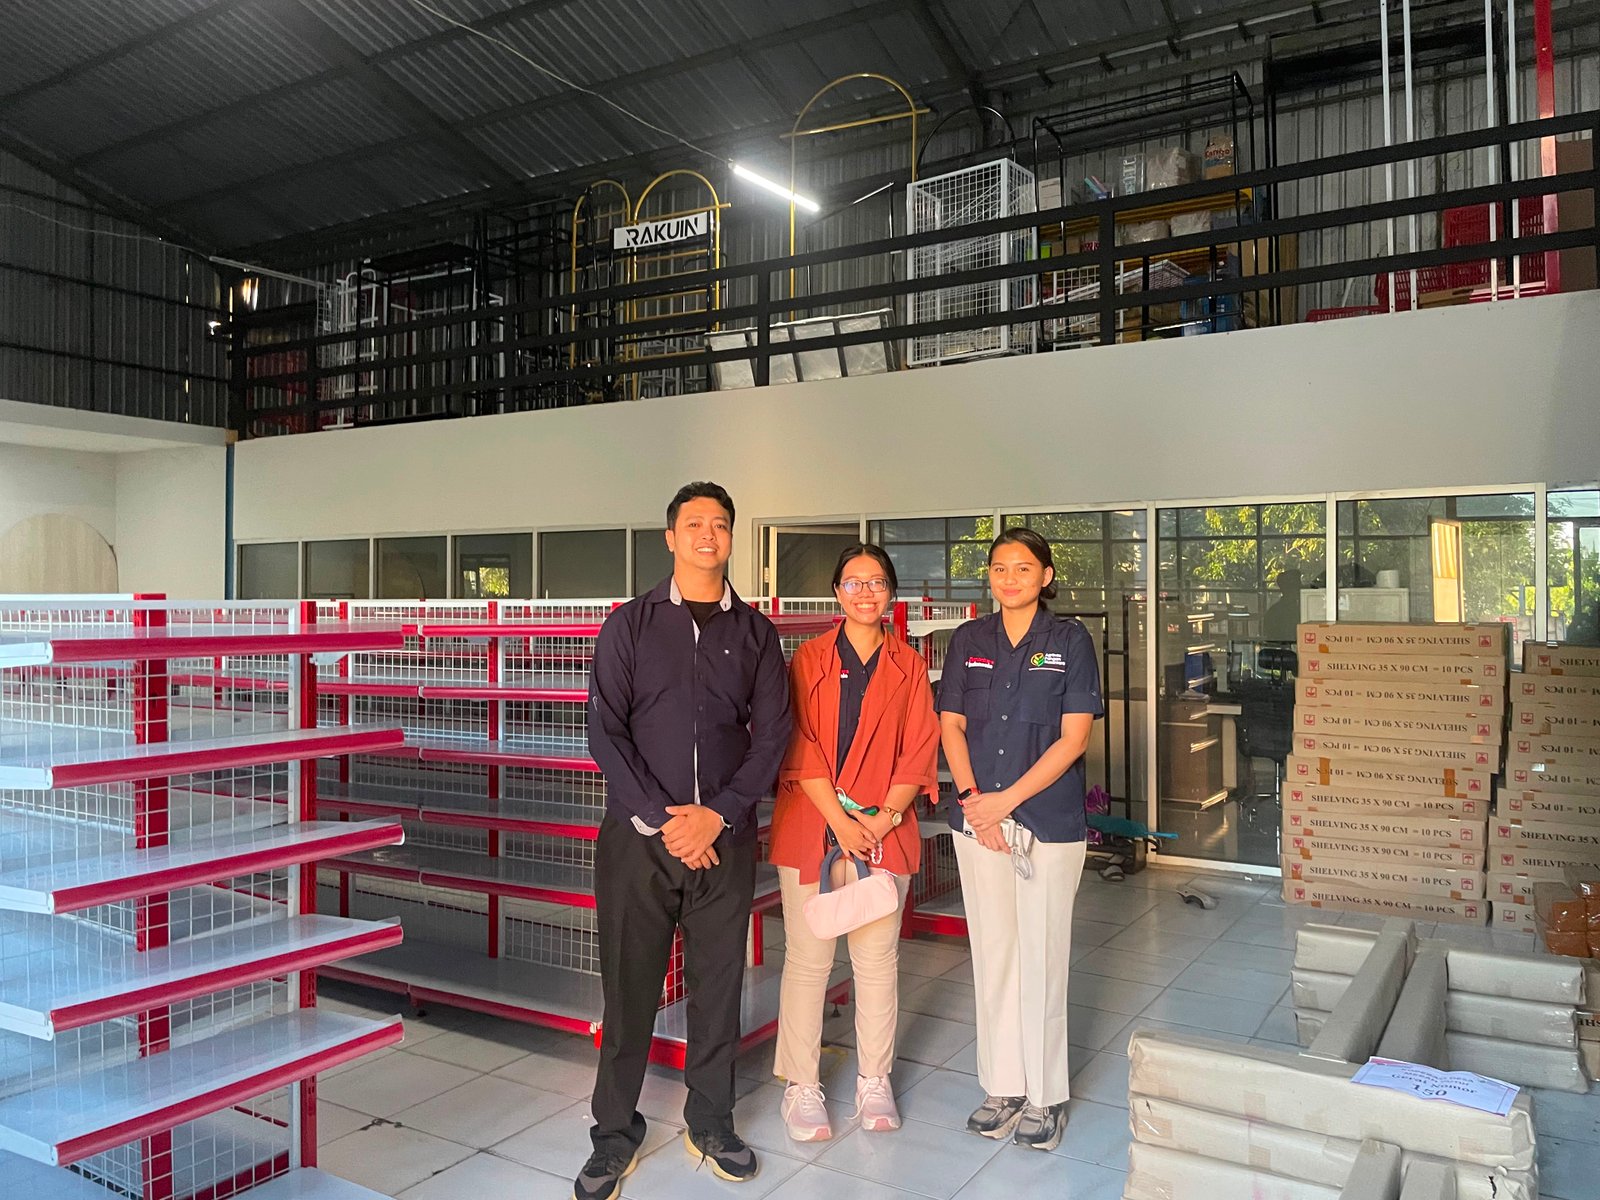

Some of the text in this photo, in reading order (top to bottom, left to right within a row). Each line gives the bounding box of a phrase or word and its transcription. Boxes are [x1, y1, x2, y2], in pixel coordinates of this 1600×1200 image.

[626, 217, 698, 246] RAKUIN
[1417, 693, 1470, 702] SHELVING
[1545, 716, 1564, 724] PCS
[1416, 722, 1467, 732] SHELVING
[1415, 748, 1466, 759] SHELVING
[1312, 795, 1359, 804] SHELVING
[1310, 820, 1357, 830] SHELVING
[1521, 831, 1575, 842] SHELVING
[1311, 842, 1358, 852] SHELVING
[1434, 852, 1452, 861] PCS
[1523, 858, 1576, 867] SHELVI
[1310, 867, 1357, 878] SHELVING
[1392, 874, 1408, 882] CM
[1433, 878, 1451, 886] PCS
[1313, 892, 1360, 903] SHELVING
[1395, 902, 1411, 910] CM
[1437, 906, 1455, 914] PCS
[1413, 1084, 1447, 1096] 150
